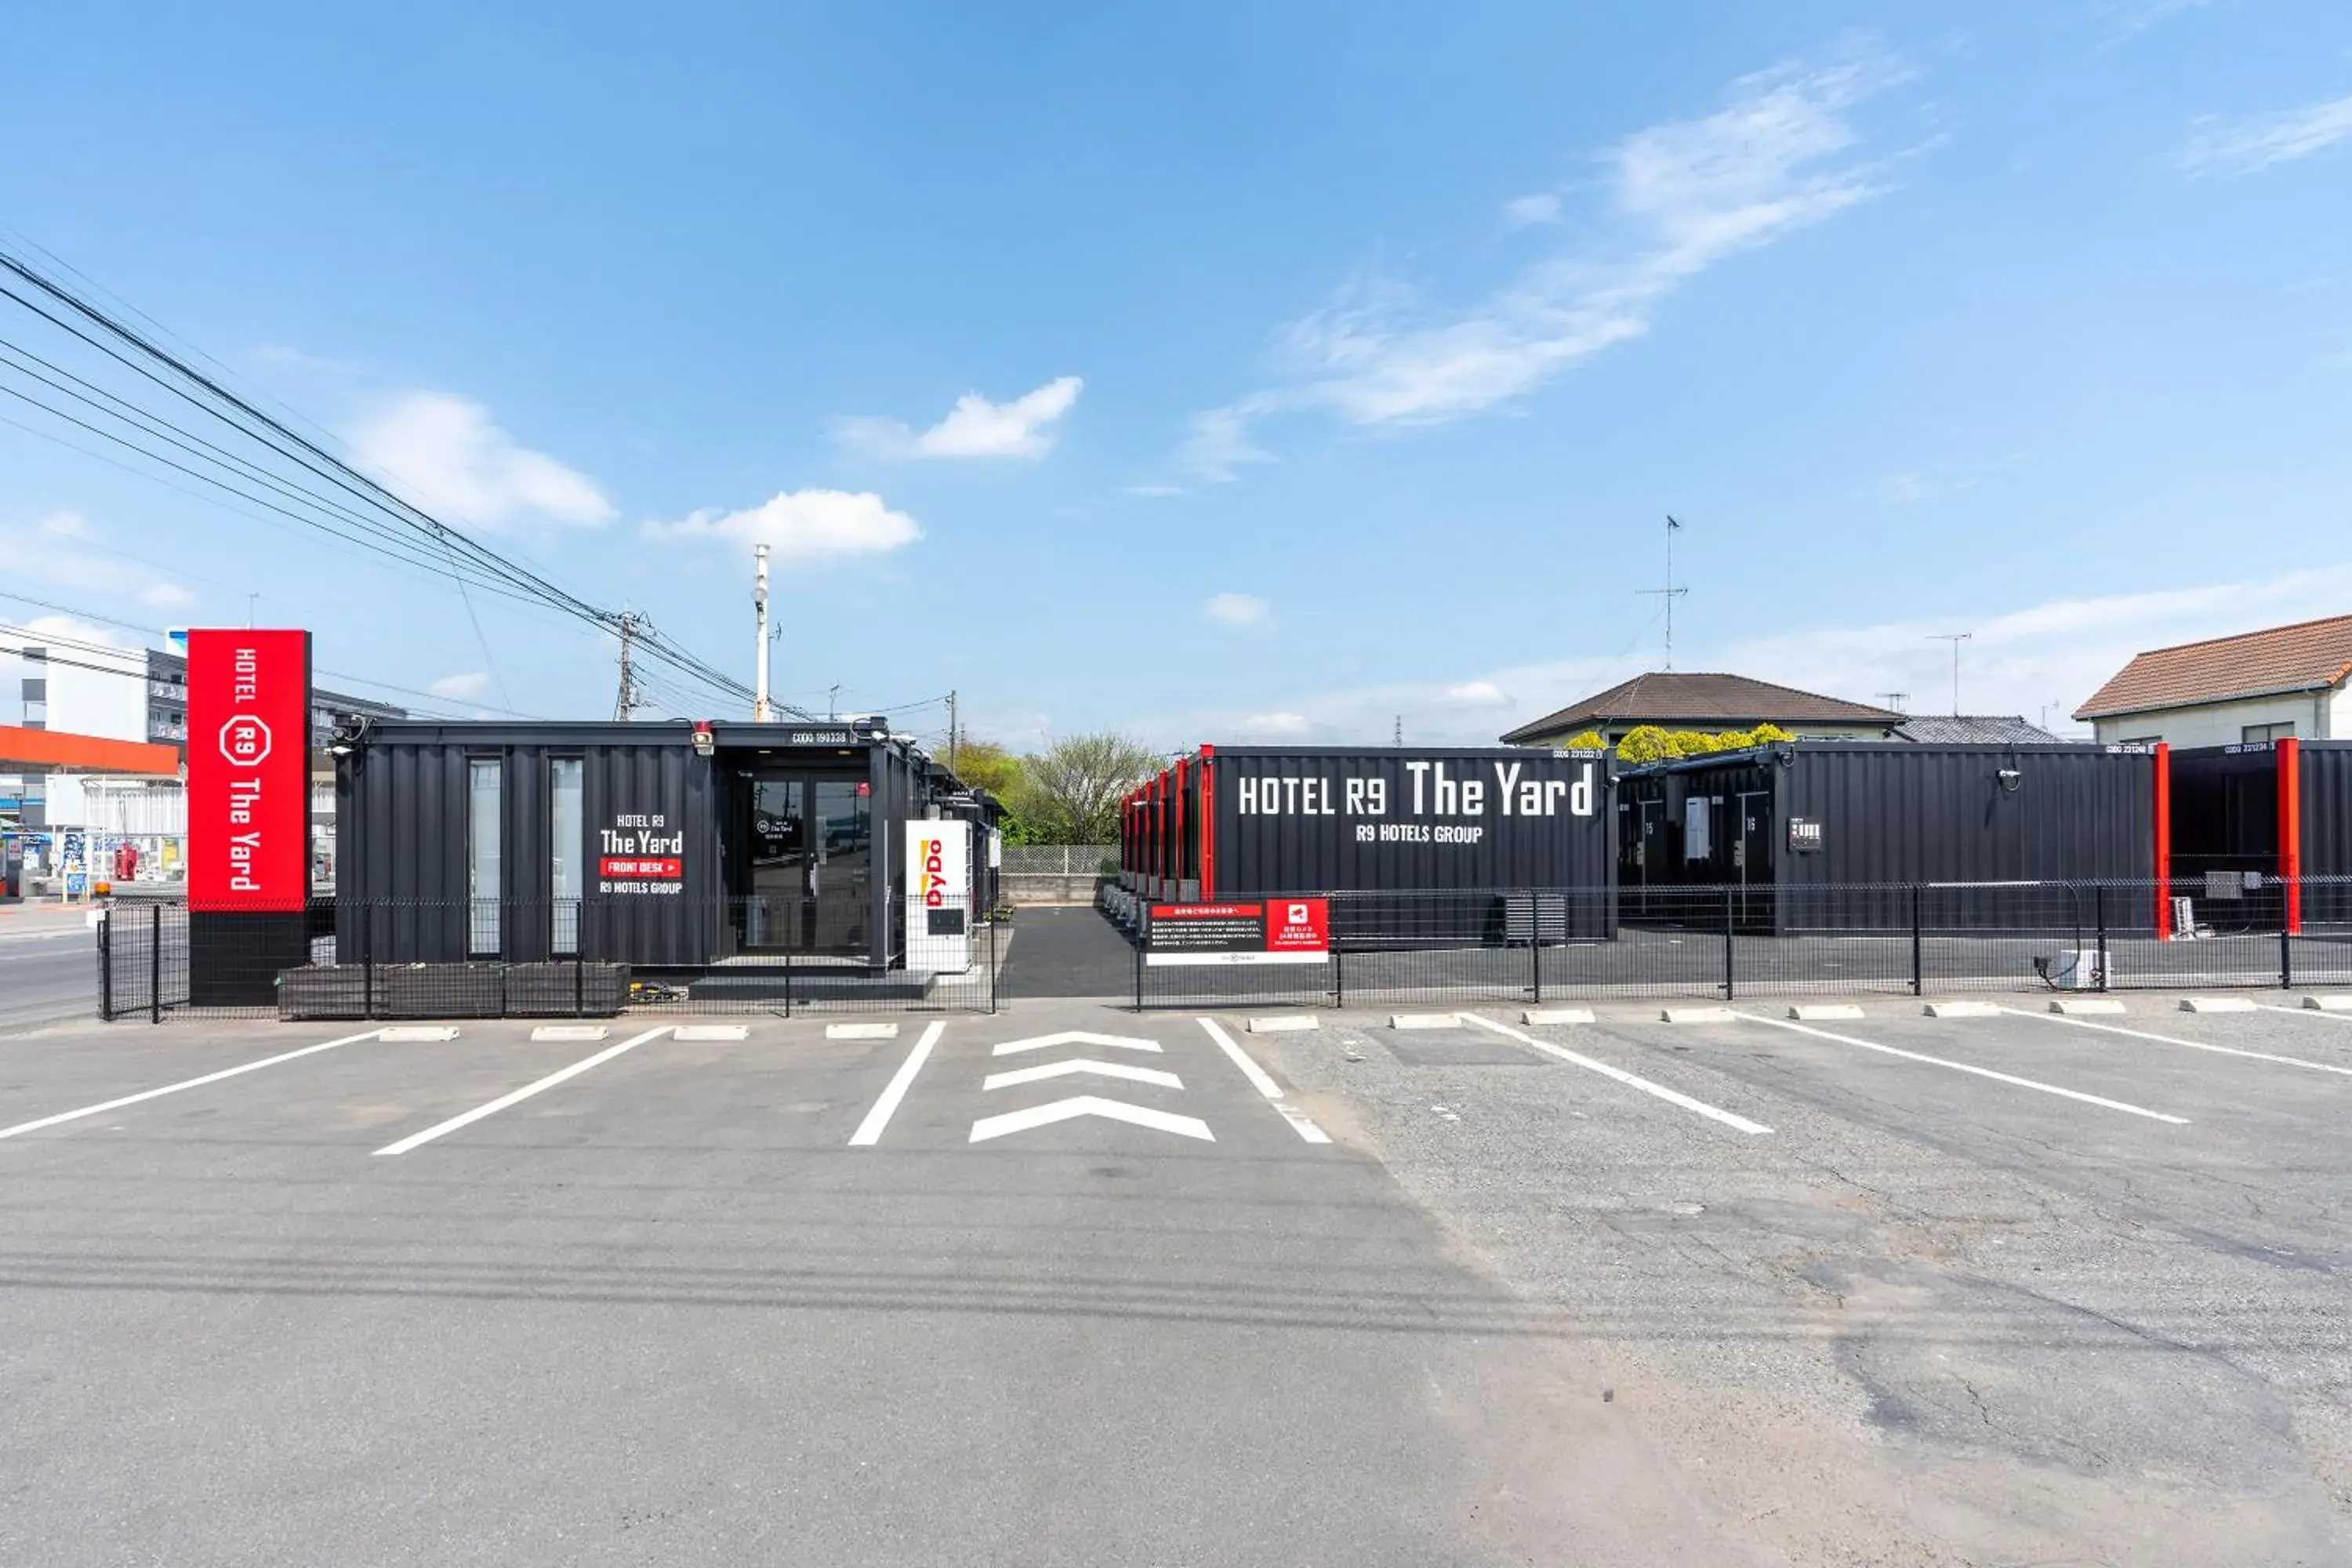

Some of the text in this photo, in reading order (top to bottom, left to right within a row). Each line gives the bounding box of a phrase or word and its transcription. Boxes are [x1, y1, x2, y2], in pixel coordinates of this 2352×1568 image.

[235, 648, 256, 703] HOTEL
[235, 727, 256, 753] R9
[1239, 761, 1593, 816] HOTEL R9 The Yard
[617, 815, 664, 827] HOTEL R9
[230, 777, 261, 891] The Yard
[600, 829, 683, 854] The Yard
[1356, 824, 1483, 844] R9 HOTELS GROUP
[608, 862, 663, 873] FRONT DESK
[927, 840, 946, 906] DyDo
[600, 882, 683, 895] R9 HOTELS GROUP
